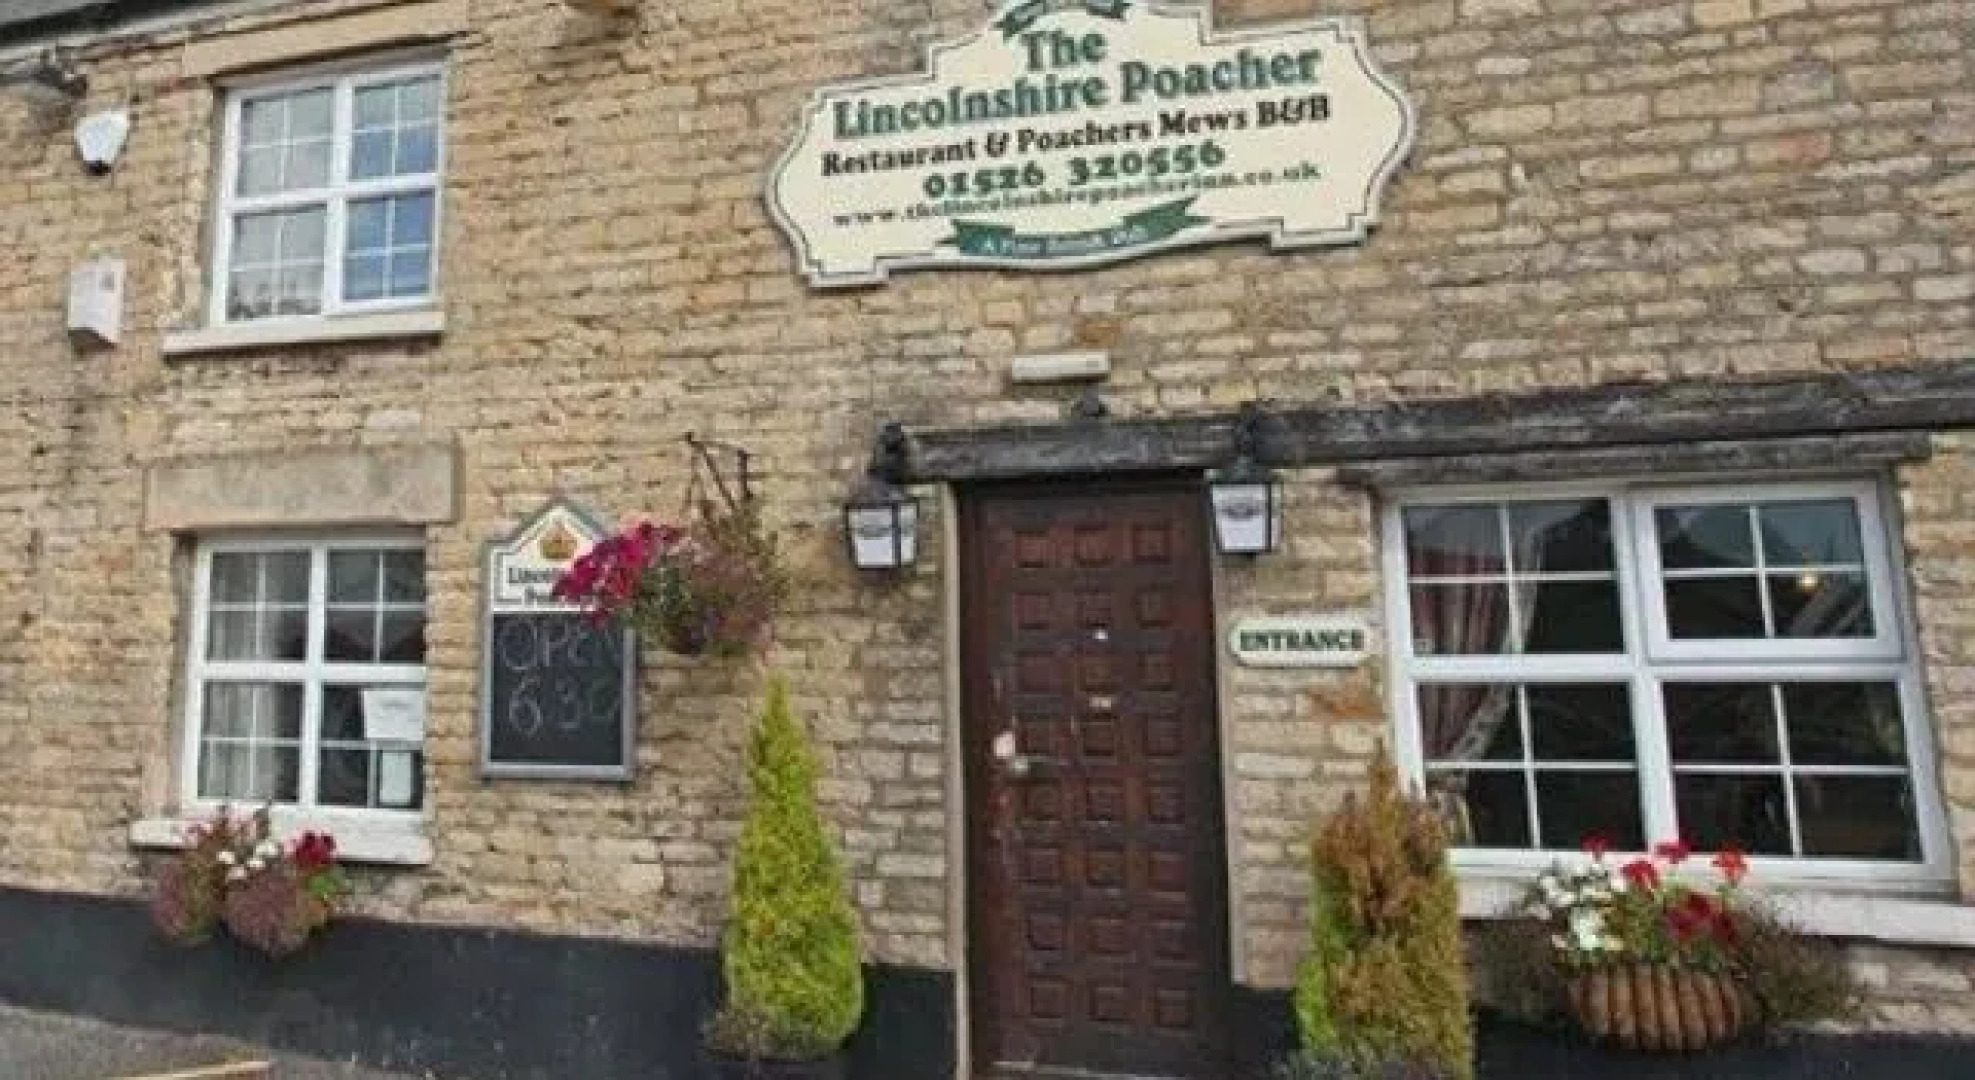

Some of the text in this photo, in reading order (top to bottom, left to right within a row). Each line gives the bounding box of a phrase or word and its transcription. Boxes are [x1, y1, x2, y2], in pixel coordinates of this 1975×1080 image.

[1020, 28, 1108, 72] The
[832, 48, 1322, 141] Lincolnshire Poacher
[820, 94, 1330, 177] Restaurant & Poachers Mews B&B
[922, 139, 1226, 199] 01526 320556
[1240, 629, 1365, 652] ENTRANCE
